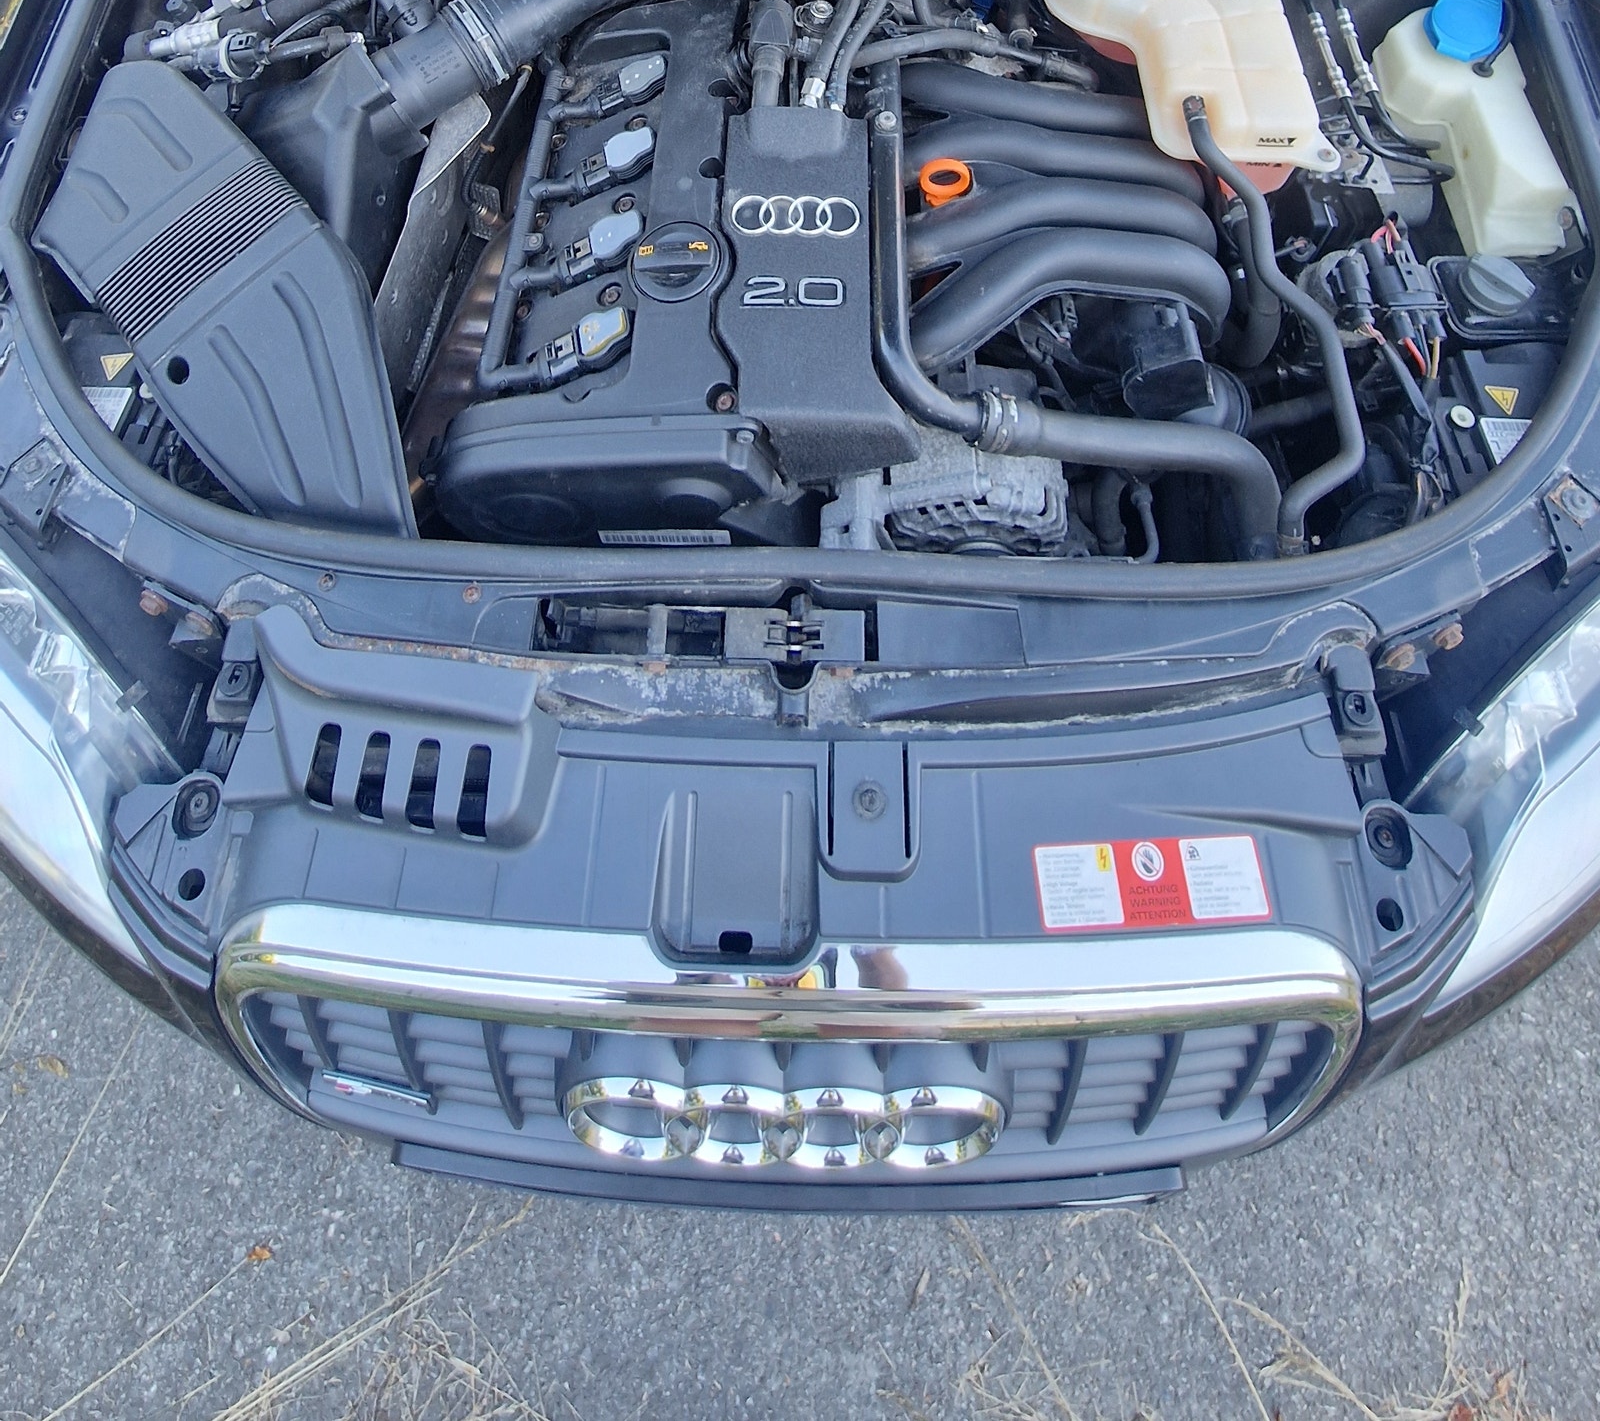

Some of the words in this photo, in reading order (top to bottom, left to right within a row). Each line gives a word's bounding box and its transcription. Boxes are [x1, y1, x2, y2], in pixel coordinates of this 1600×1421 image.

[742, 276, 844, 307] 2.0
[1128, 884, 1178, 895] ACHTUNG
[1130, 896, 1181, 907] WARNING
[1130, 909, 1186, 920] ATTENTION
